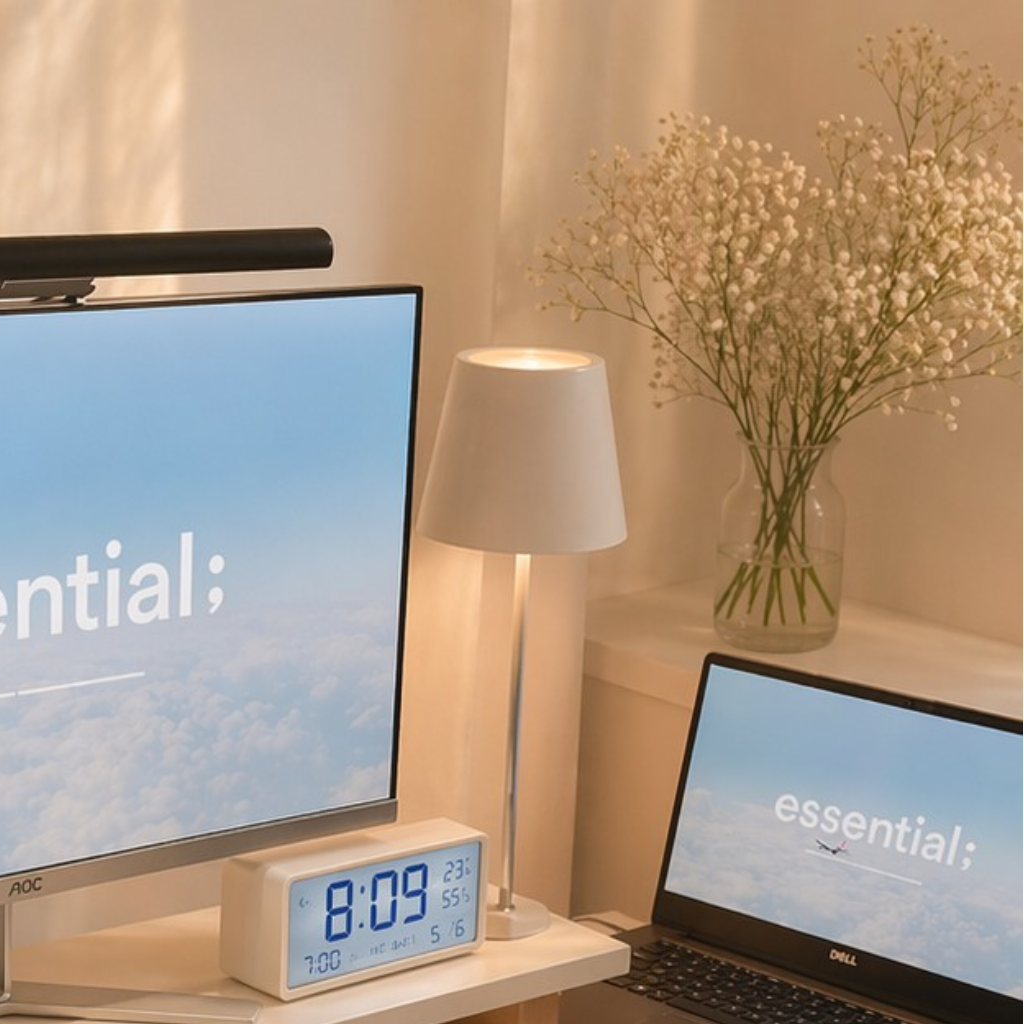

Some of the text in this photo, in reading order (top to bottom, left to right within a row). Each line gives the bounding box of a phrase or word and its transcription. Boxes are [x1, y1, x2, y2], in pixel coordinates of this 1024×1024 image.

[774, 794, 976, 871] essential;
[7, 876, 43, 898] AOC
[325, 863, 428, 943] 8:09
[304, 949, 341, 975] 7:00
